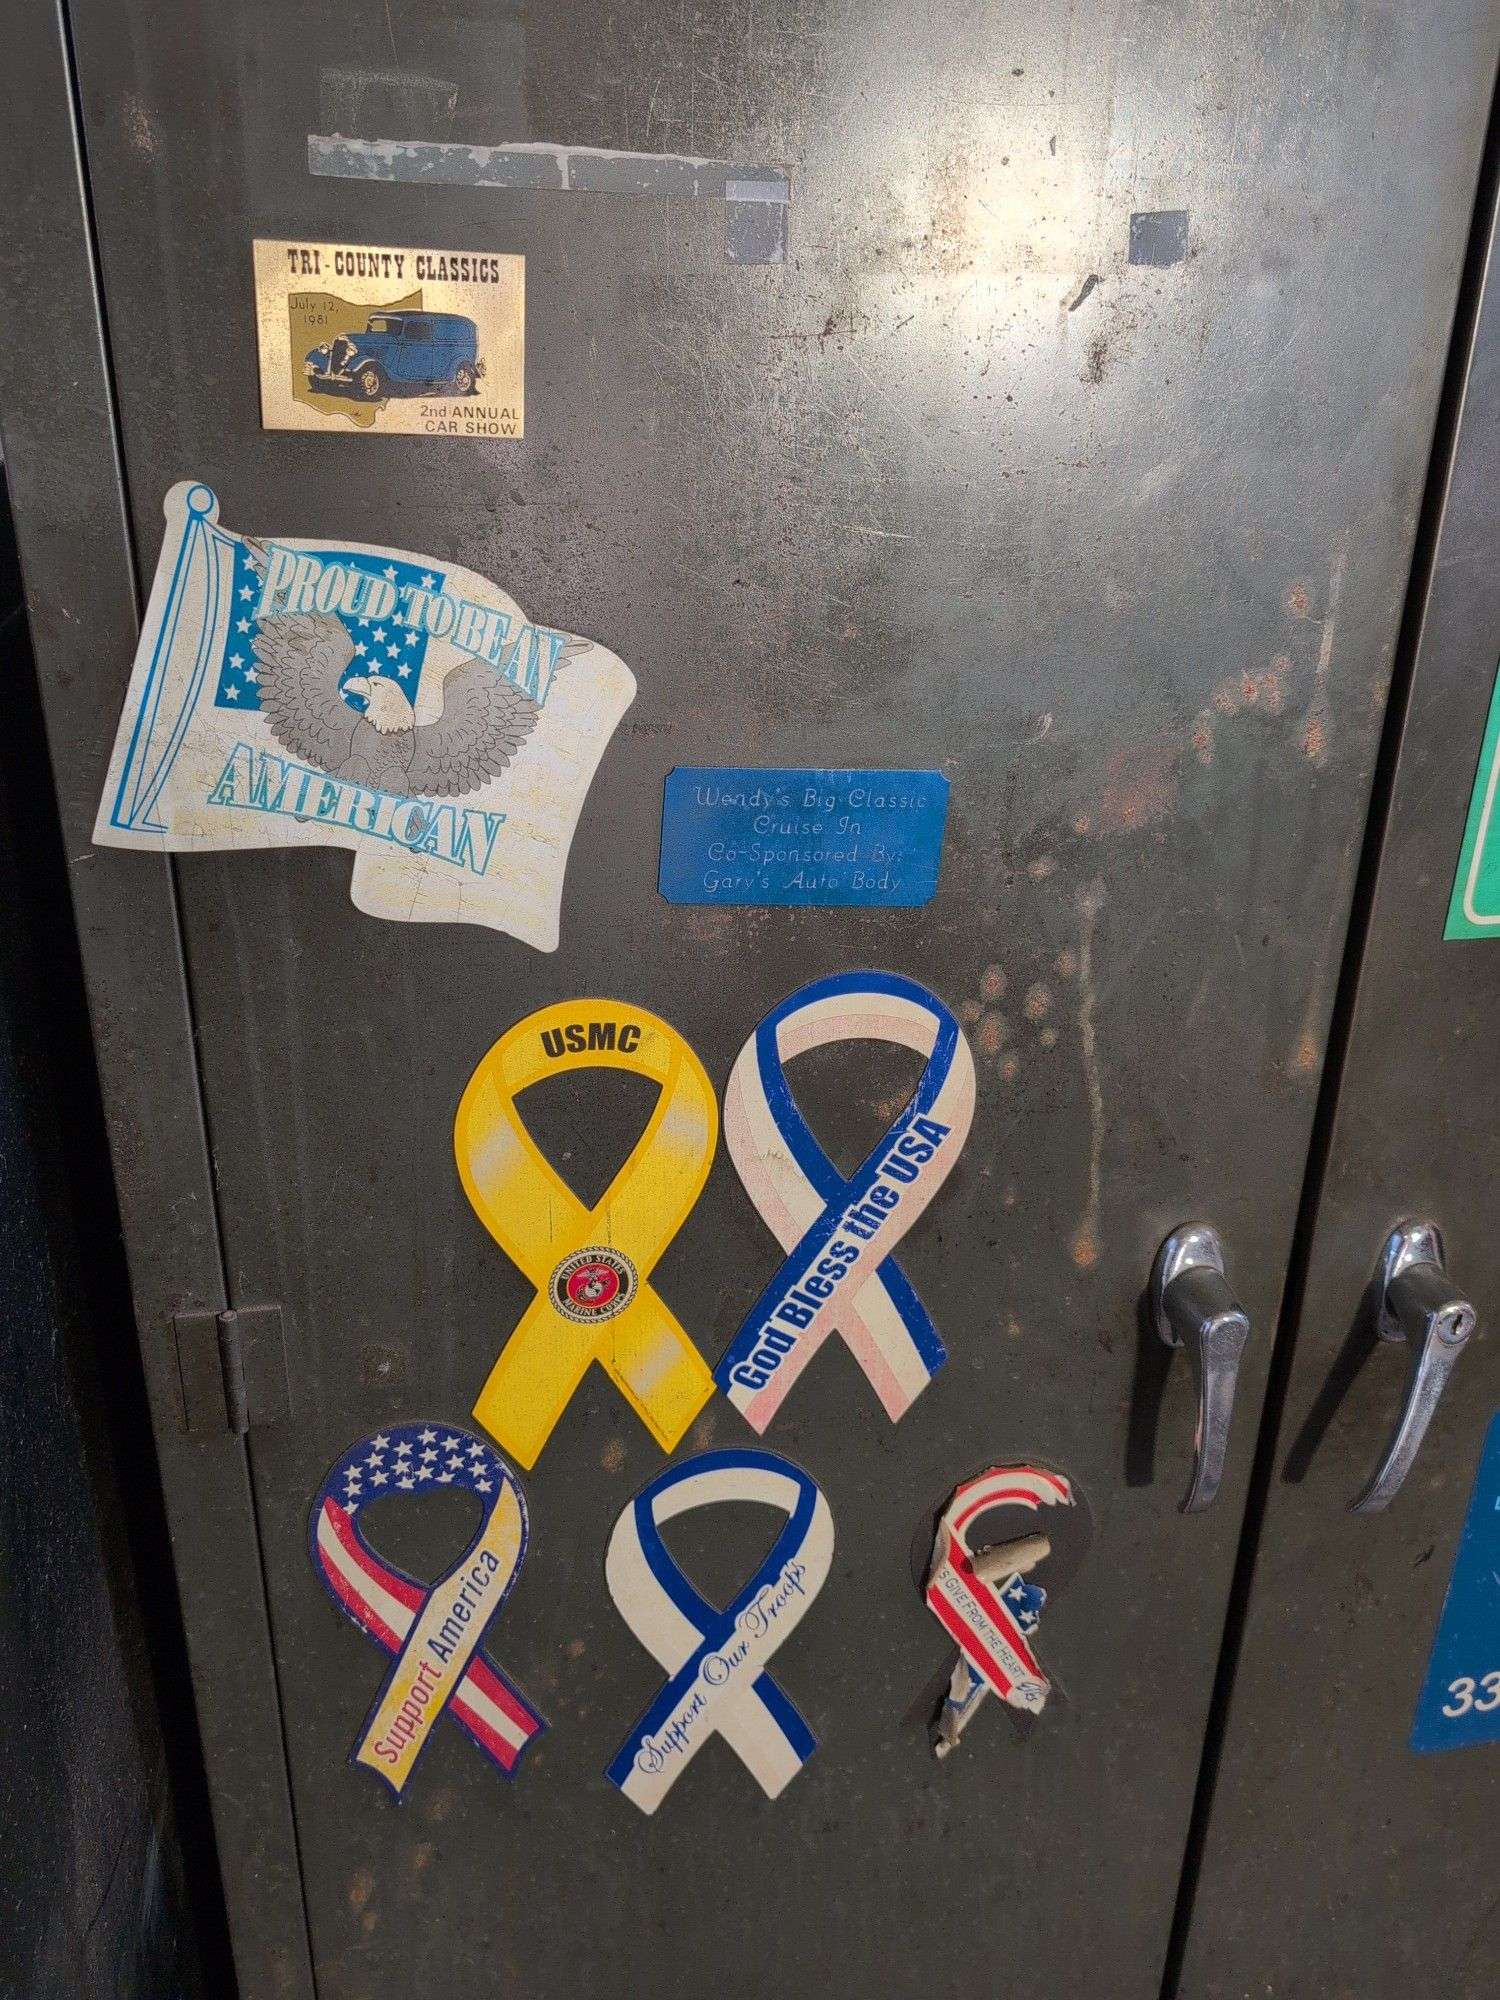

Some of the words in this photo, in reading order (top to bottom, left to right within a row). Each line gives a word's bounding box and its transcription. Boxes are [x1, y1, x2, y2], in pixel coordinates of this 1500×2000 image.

[416, 255, 500, 285] CLASSICS
[290, 296, 316, 312] July
[303, 313, 328, 326] 1981
[420, 404, 447, 418] 2nd
[451, 406, 520, 420] ANNUAL
[425, 420, 459, 434] CAR
[465, 421, 517, 436] SHOW
[256, 545, 397, 622] PROUD
[403, 582, 456, 638] TO
[450, 600, 513, 668] BE
[502, 624, 566, 708] AN
[208, 741, 506, 876] AMERICAN
[695, 785, 791, 810] Wendy's
[802, 787, 836, 812] Big
[848, 787, 929, 809] Classic
[753, 814, 823, 836] Cruise
[836, 815, 863, 836] In
[707, 841, 859, 866] Co-Sponsored
[703, 868, 770, 893] Gary's
[783, 871, 839, 890] Auto
[851, 870, 903, 892] Body
[540, 1022, 641, 1058] USMC
[732, 1326, 797, 1391] God
[777, 1240, 861, 1329] Bless
[841, 1184, 900, 1242] the
[882, 1117, 952, 1185] USA
[561, 1255, 593, 1281] UNITED
[596, 1255, 626, 1275] STATES
[562, 1298, 598, 1316] MARINE
[600, 1293, 626, 1313] CORPS
[945, 1577, 968, 1604] GIVE
[962, 1601, 989, 1633] FROM
[983, 1628, 1003, 1650] THE
[999, 1646, 1027, 1680] HEART
[373, 1659, 443, 1764] Support
[427, 1549, 501, 1664] America
[636, 1692, 708, 1775] Support
[702, 1640, 751, 1687] Our
[738, 1563, 807, 1639] Troops
